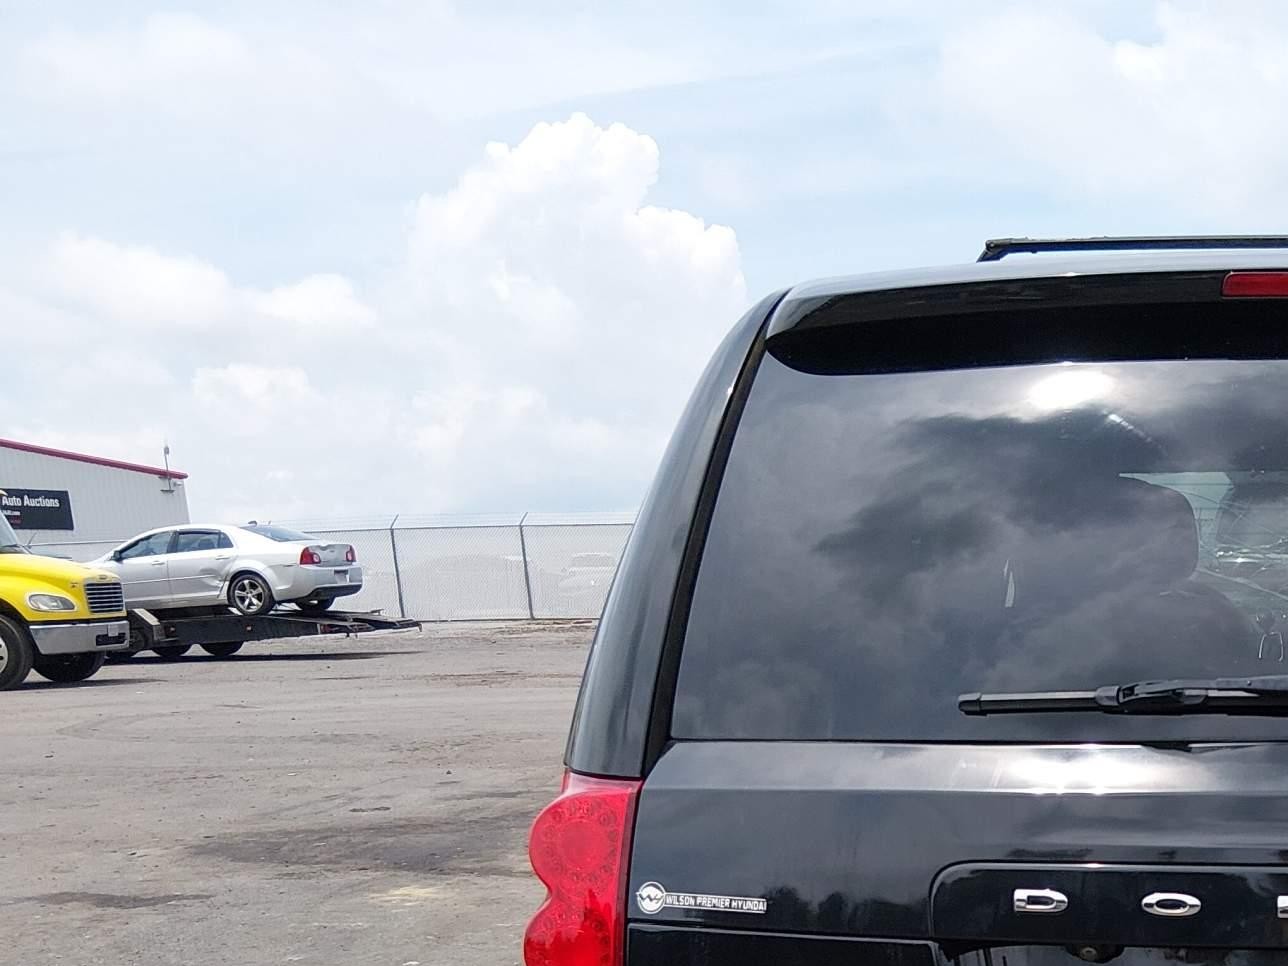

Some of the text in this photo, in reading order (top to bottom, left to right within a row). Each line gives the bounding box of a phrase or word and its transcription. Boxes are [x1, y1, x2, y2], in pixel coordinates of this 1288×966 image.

[2, 495, 60, 507] Auto Auctions
[666, 895, 767, 911] WILSON PREMIER HYUNDAI
